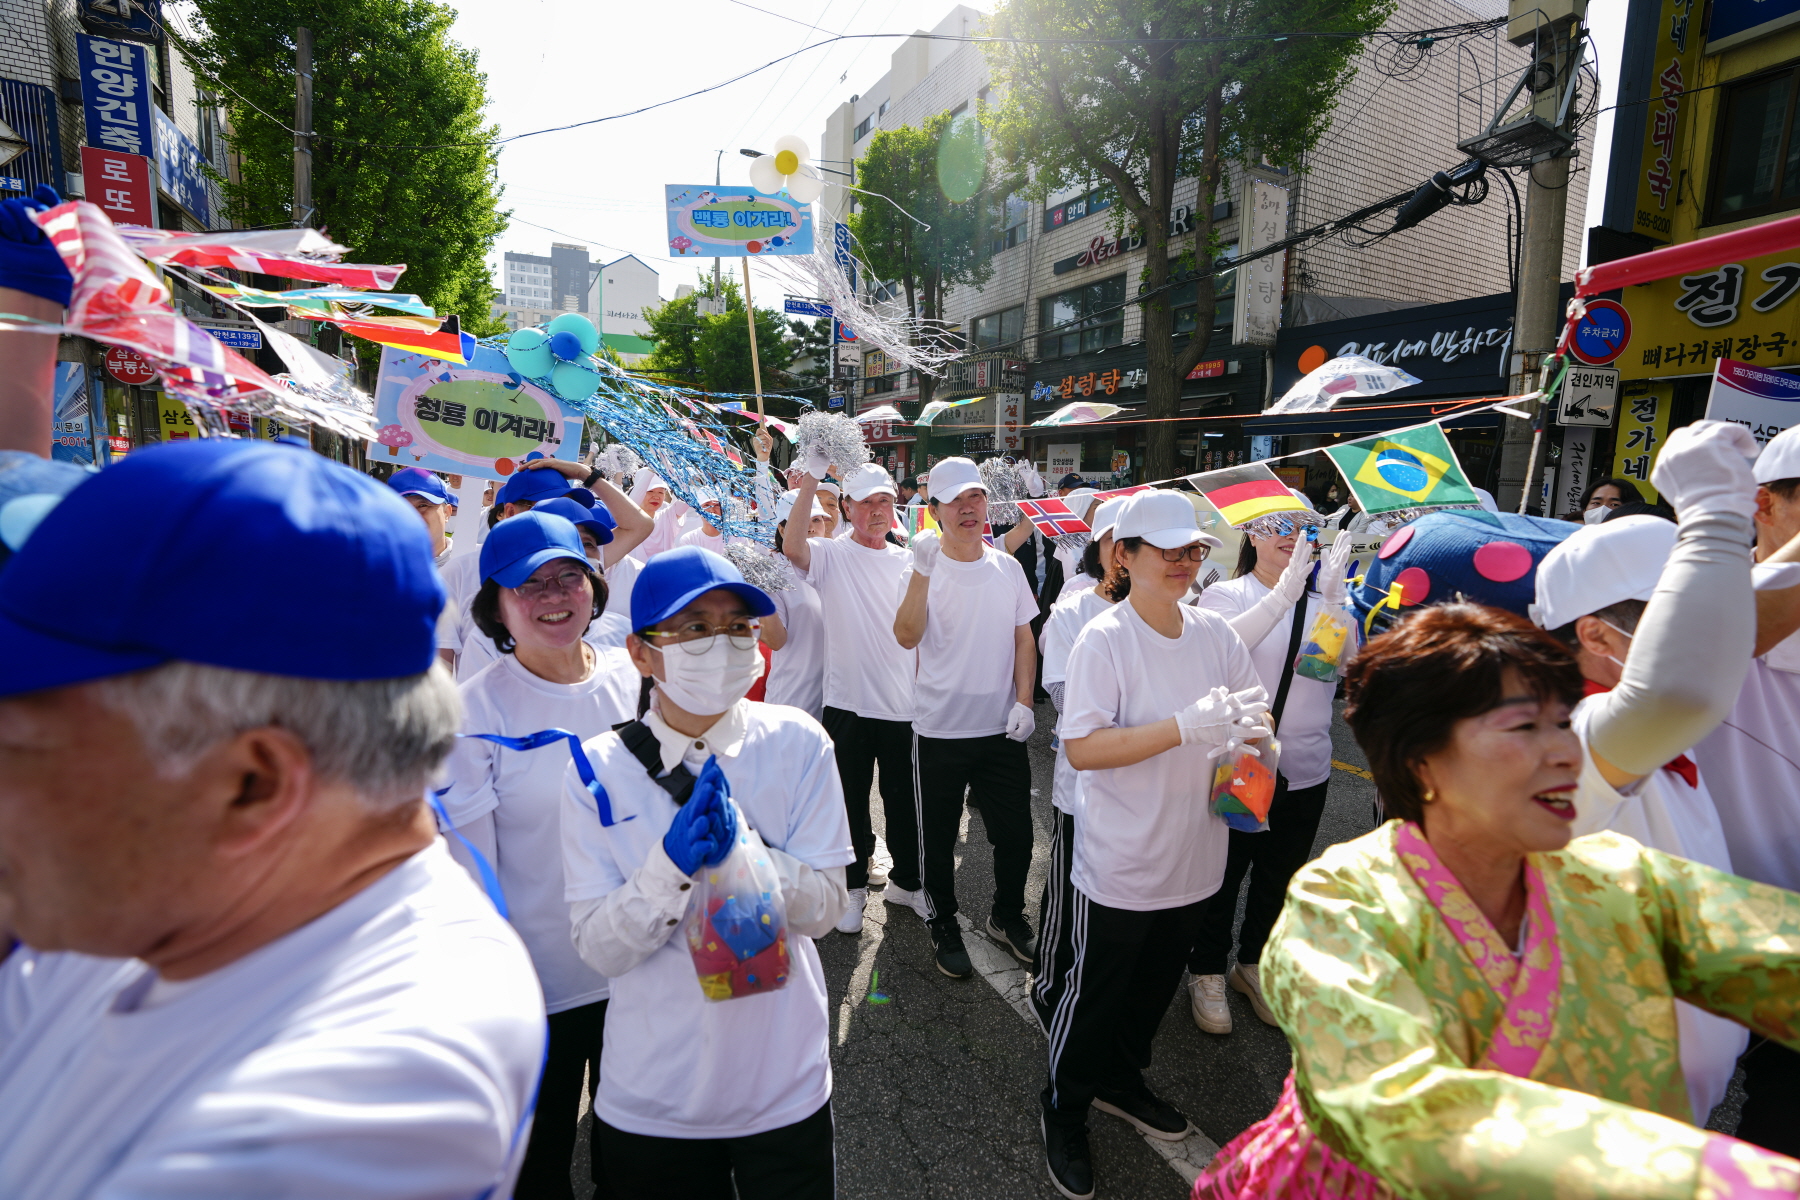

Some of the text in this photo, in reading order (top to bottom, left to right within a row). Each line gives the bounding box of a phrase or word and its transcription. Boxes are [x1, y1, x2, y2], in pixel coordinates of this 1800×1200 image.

[89, 39, 142, 155] 한양건축
[101, 157, 136, 213] 로또
[692, 210, 729, 228] 백룡
[1067, 200, 1087, 221] 안마
[1637, 210, 1671, 234] 995-8200
[1582, 326, 1620, 339] 주차금지
[108, 359, 155, 376] 부동산
[1205, 361, 1222, 371] 1995
[1057, 368, 1124, 399] 설렁탕
[1126, 368, 1148, 389] 갈
[1570, 372, 1615, 389] 견인지역
[162, 409, 195, 426] 삼성
[414, 396, 467, 428] 청룡
[51, 421, 84, 434] 시문의
[51, 436, 88, 448] -0011
